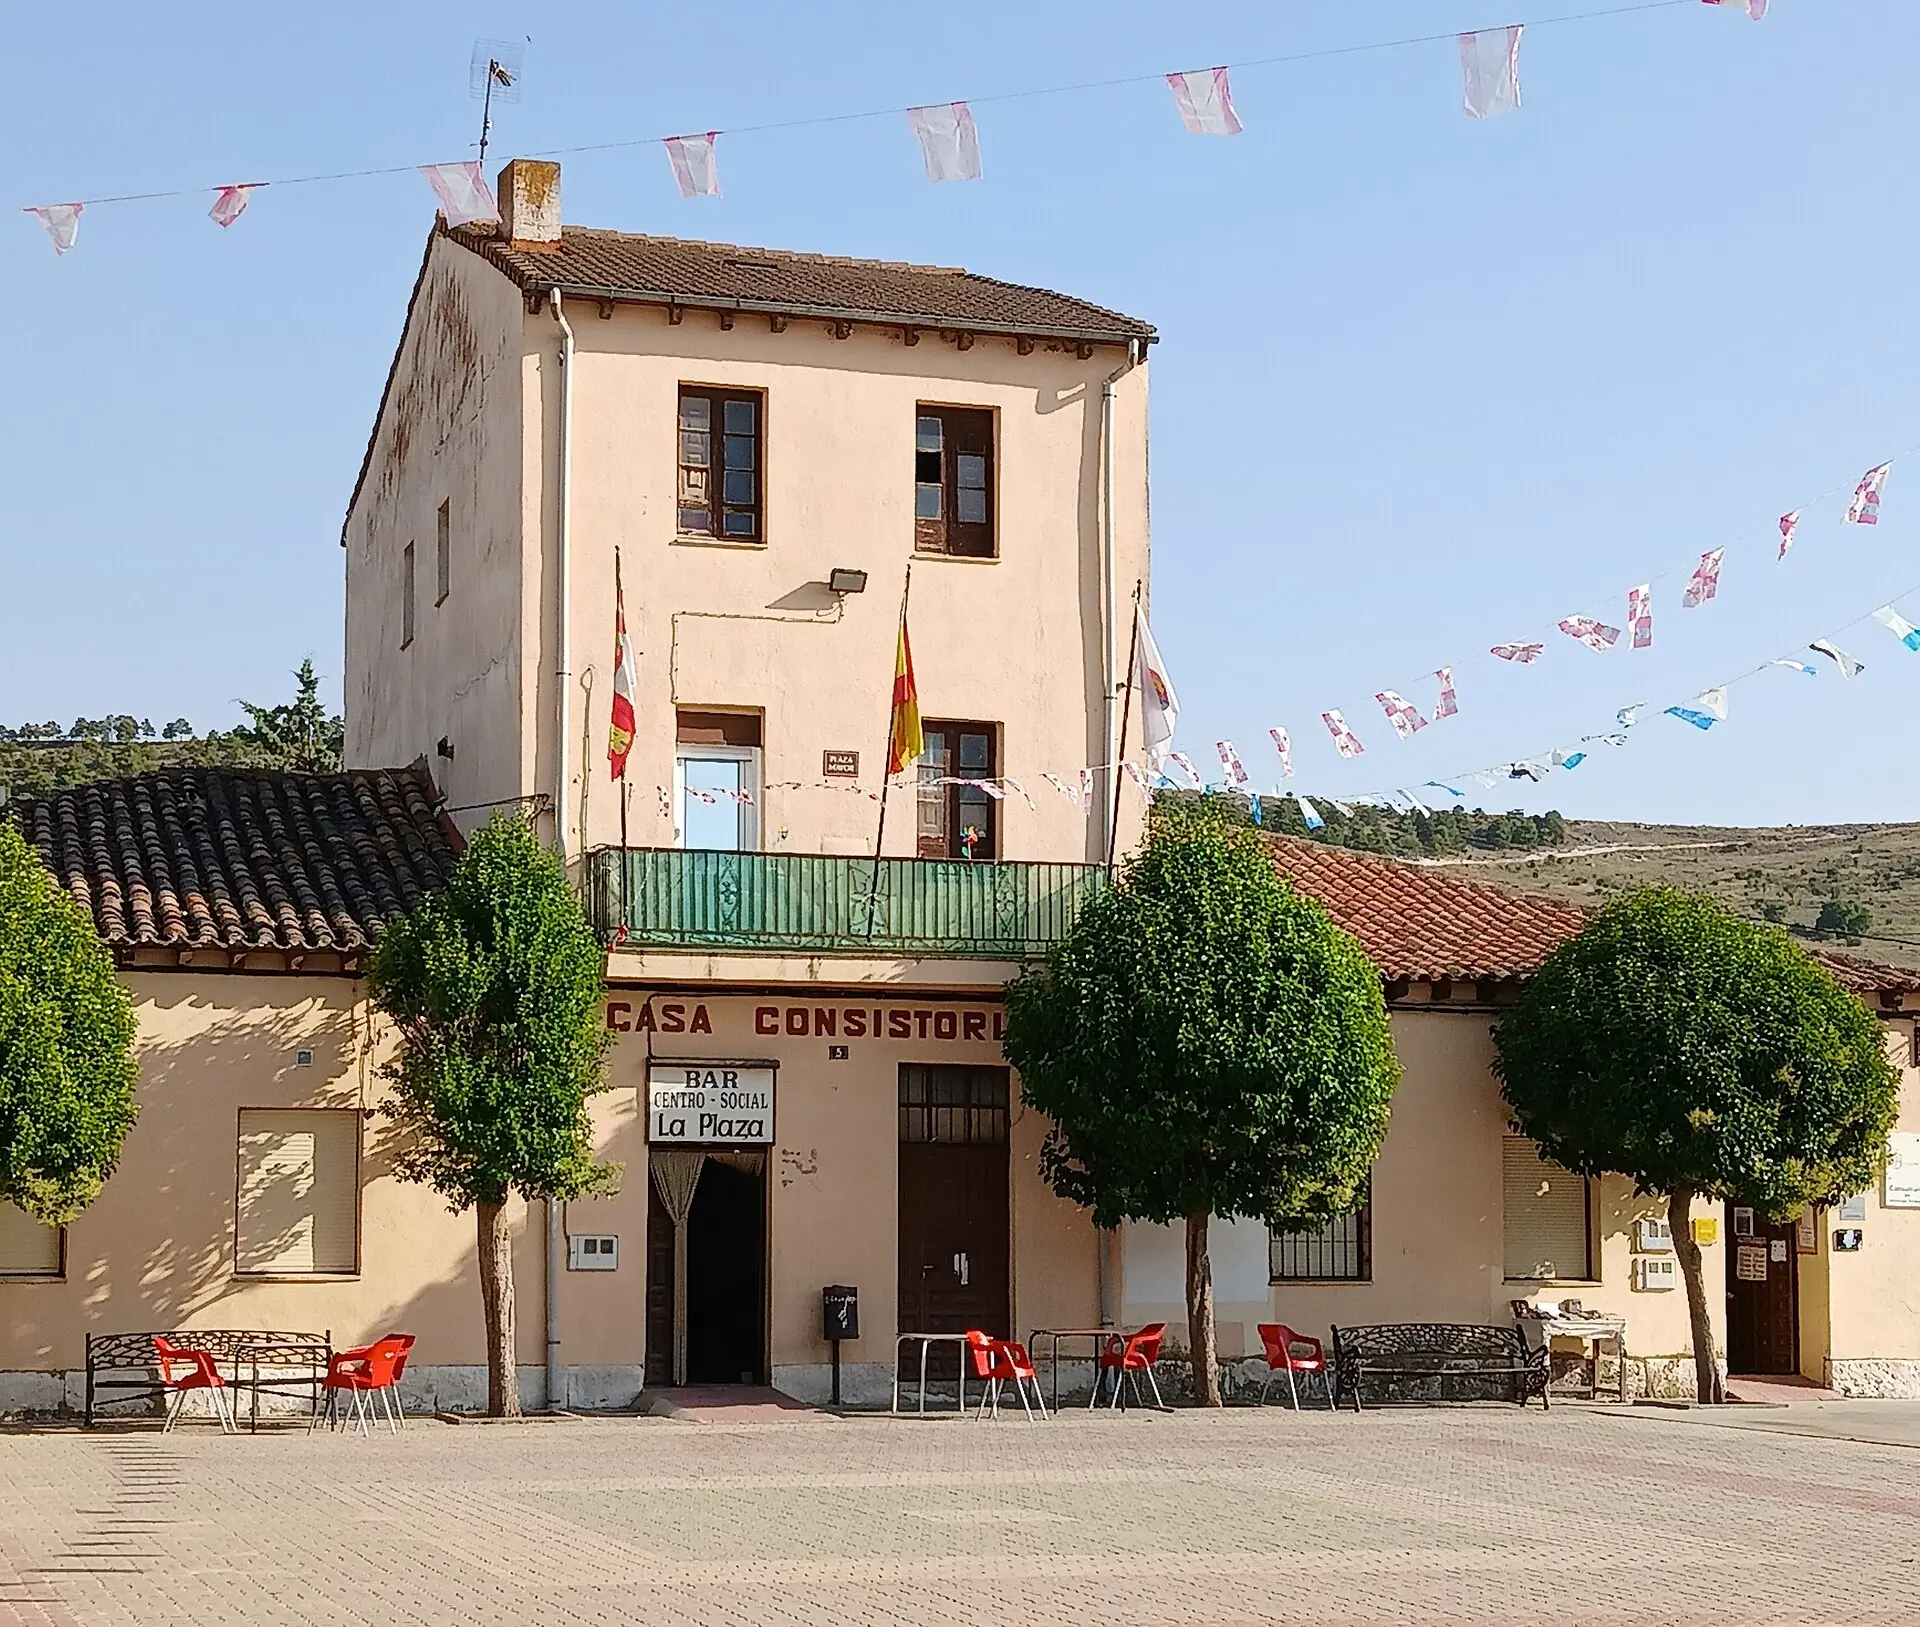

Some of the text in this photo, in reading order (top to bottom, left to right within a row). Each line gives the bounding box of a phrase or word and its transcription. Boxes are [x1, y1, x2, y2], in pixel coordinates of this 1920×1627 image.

[606, 1002, 1003, 1041] CASA CONSISTORI
[685, 1070, 739, 1089] BAR
[654, 1091, 705, 1109] CENTRO
[720, 1091, 769, 1110] SOCIAL
[658, 1112, 764, 1140] La Plaza
